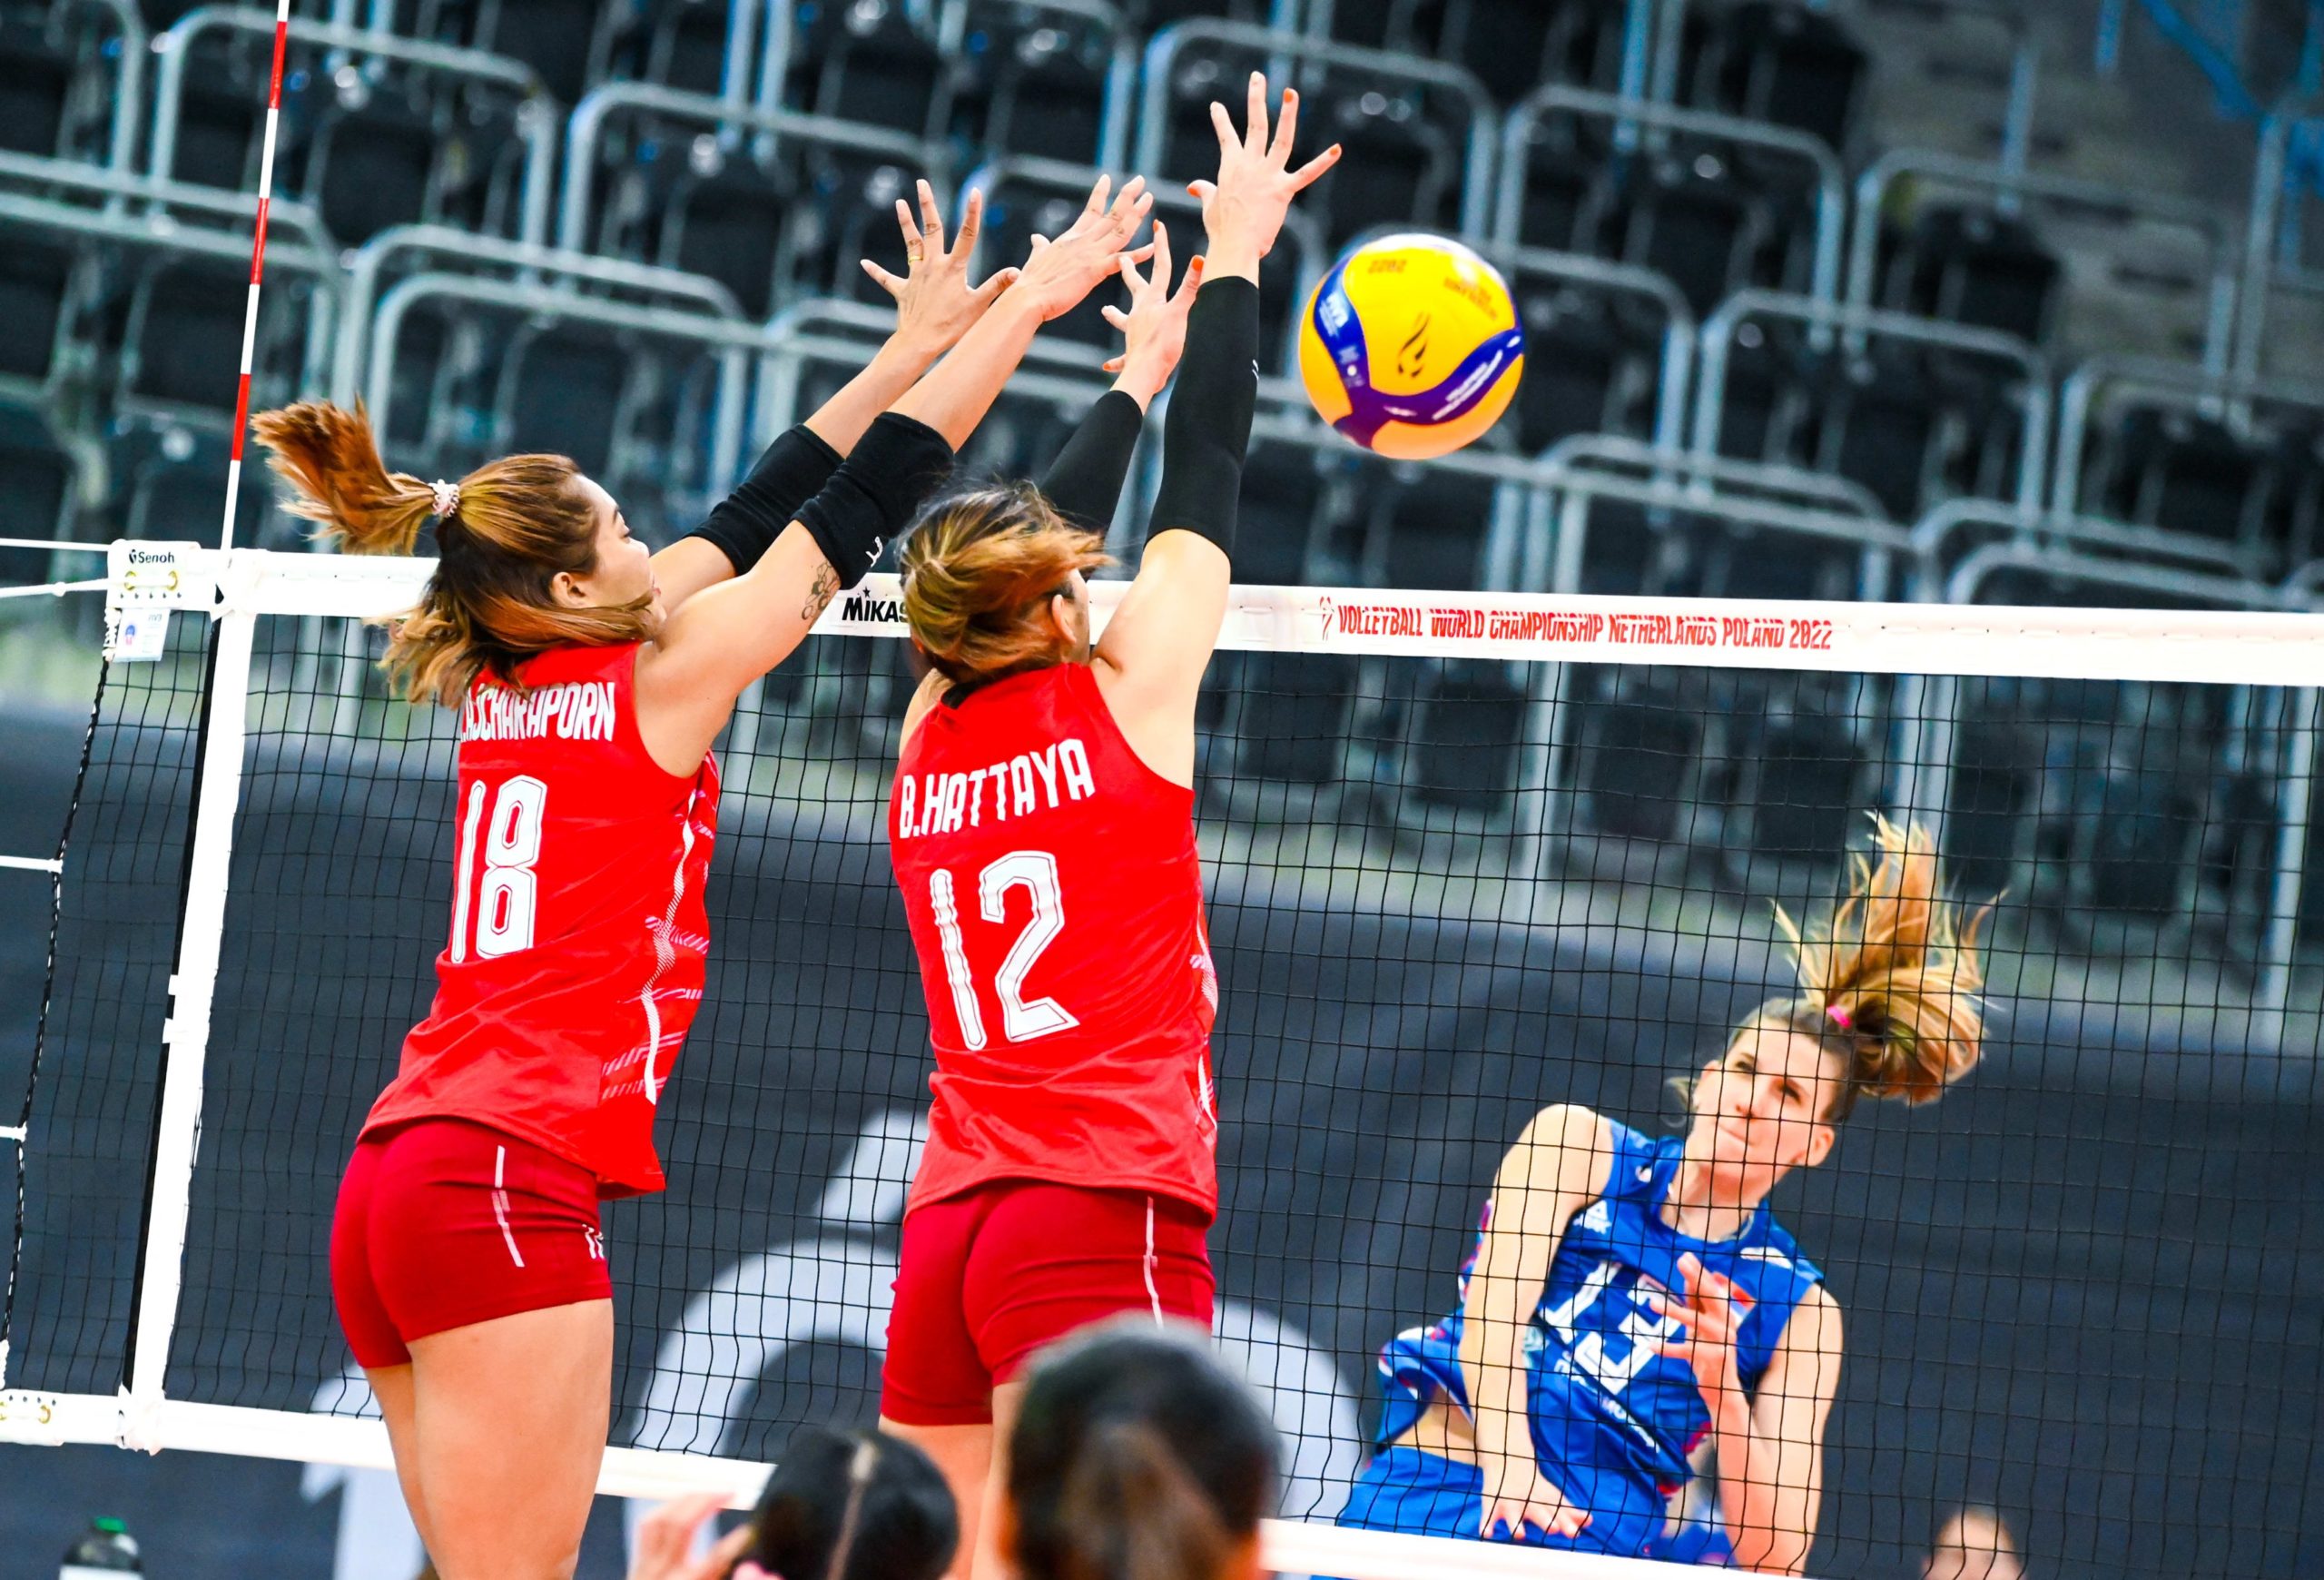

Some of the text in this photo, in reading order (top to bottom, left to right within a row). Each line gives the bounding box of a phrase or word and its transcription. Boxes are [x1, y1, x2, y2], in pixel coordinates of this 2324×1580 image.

[138, 551, 175, 564] Senoh
[1337, 605, 1833, 650] VOLLEYBALL WORLD CHAMPIONSHIP NETHERLANDS POLAND 2022
[899, 738, 1096, 839] B.HATTAYA
[451, 775, 547, 963] 18
[929, 850, 1080, 1051] 12
